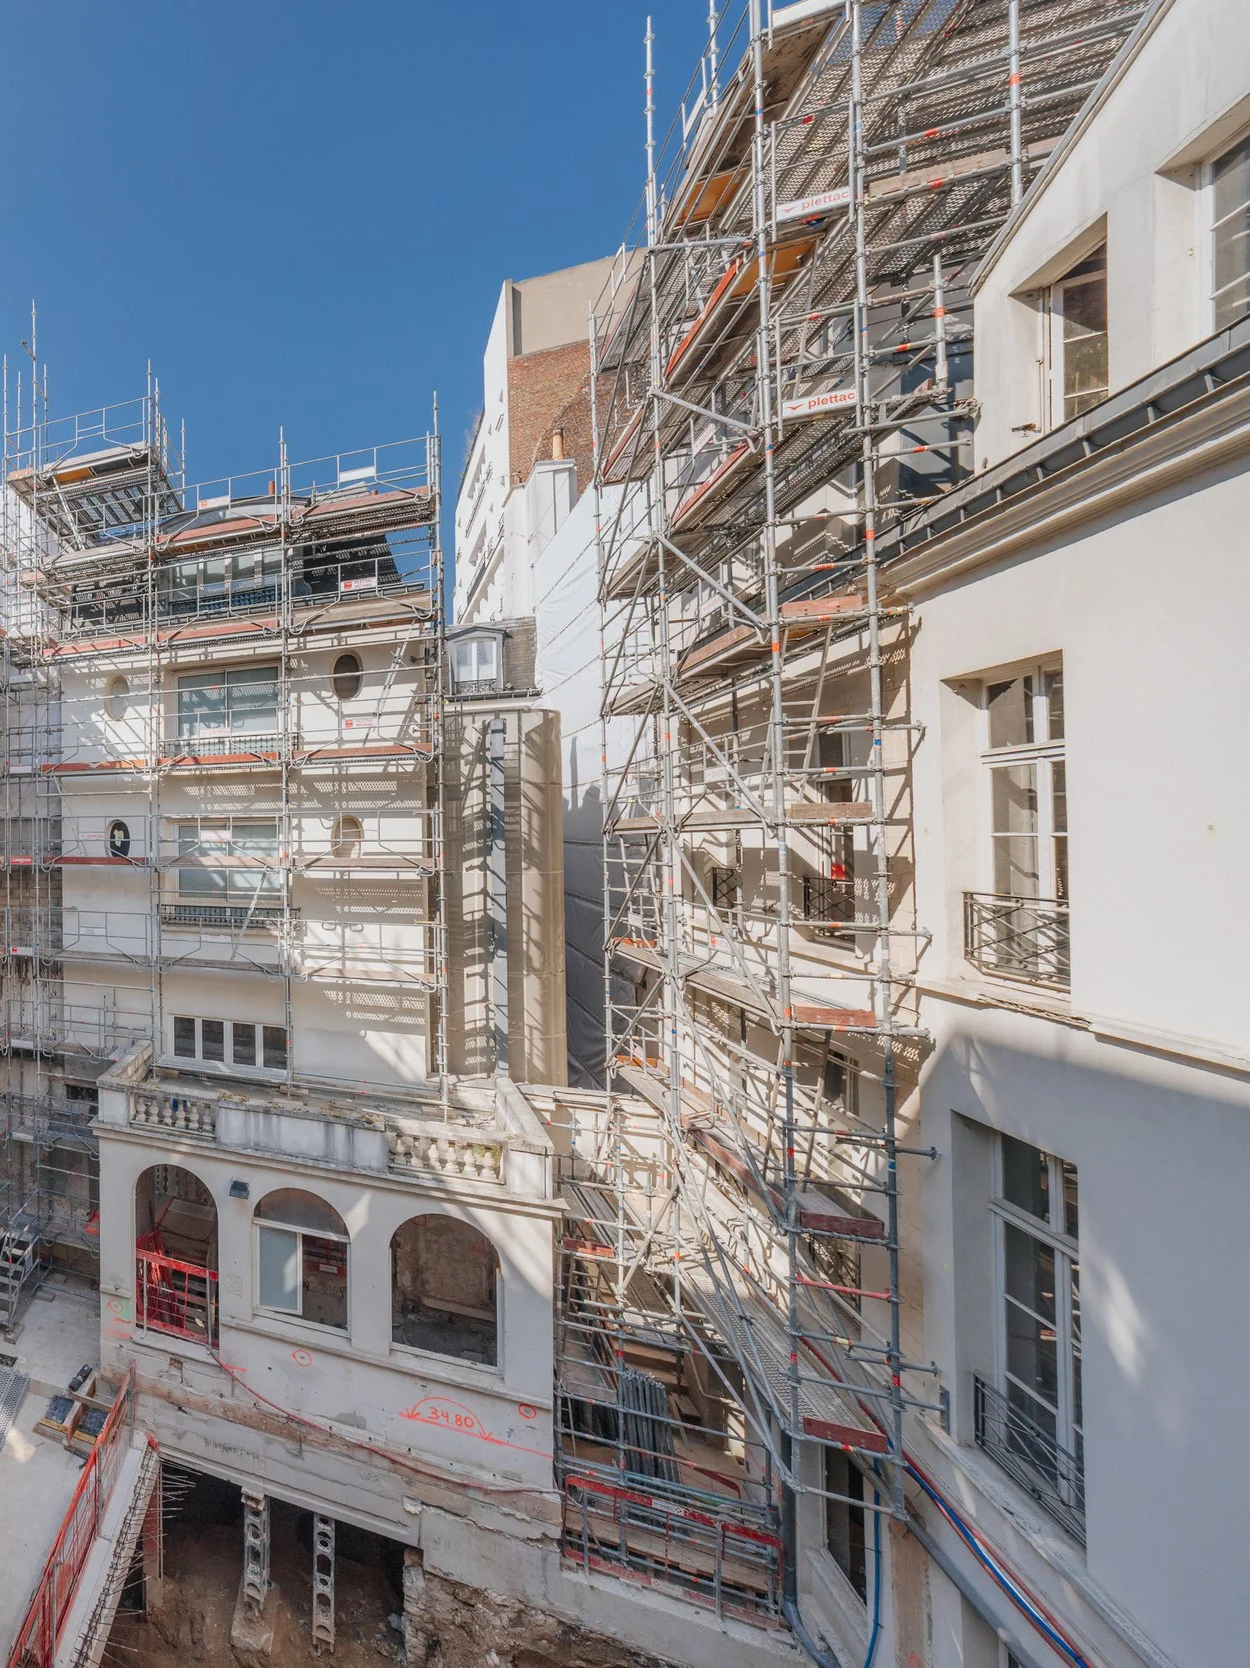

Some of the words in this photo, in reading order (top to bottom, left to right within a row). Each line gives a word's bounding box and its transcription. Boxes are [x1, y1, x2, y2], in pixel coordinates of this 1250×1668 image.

[801, 191, 849, 211] plettac
[807, 391, 855, 410] plettac
[427, 1406, 474, 1429] 34.80
